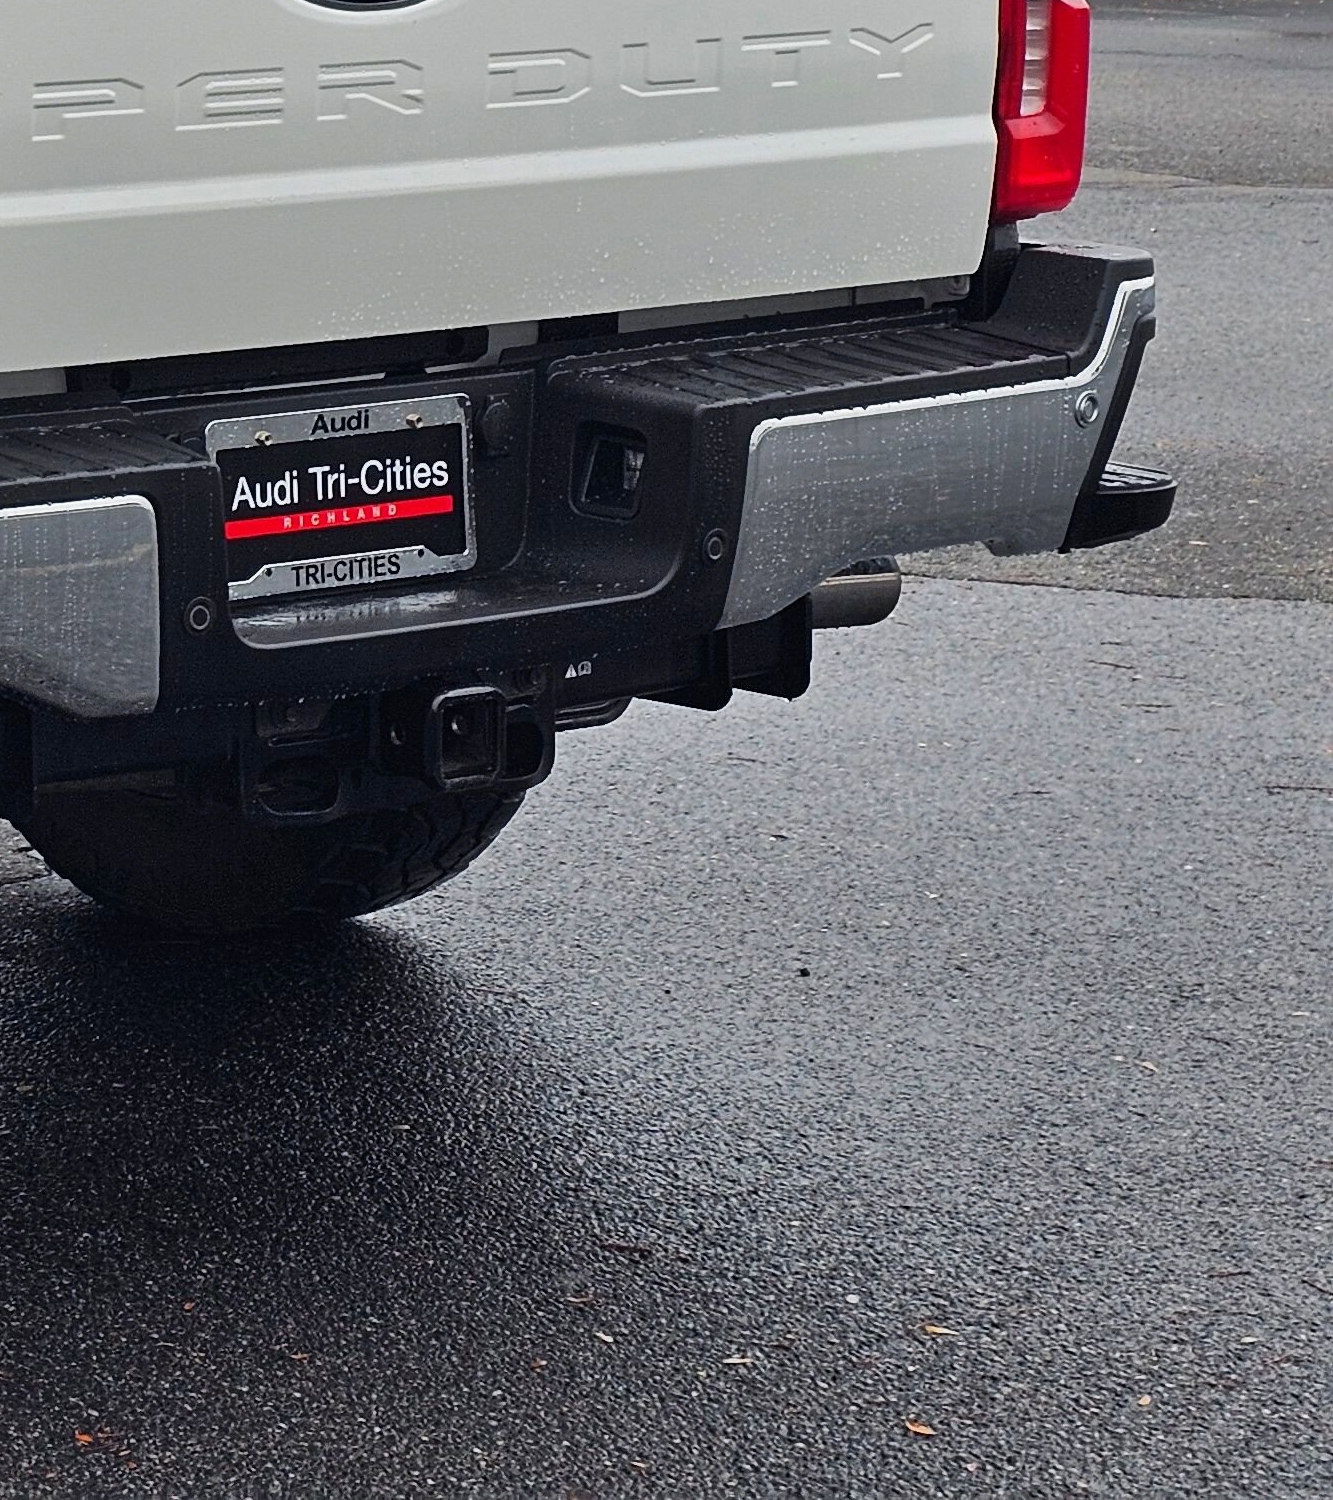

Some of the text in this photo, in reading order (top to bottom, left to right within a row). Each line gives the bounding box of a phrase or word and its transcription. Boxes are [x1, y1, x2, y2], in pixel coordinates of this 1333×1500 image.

[485, 21, 934, 110] DUTY
[310, 408, 371, 437] Audi
[231, 454, 450, 513] Audi Tri-Cities
[282, 503, 398, 530] RICHLAND
[289, 552, 402, 588] TRI-CITIES
